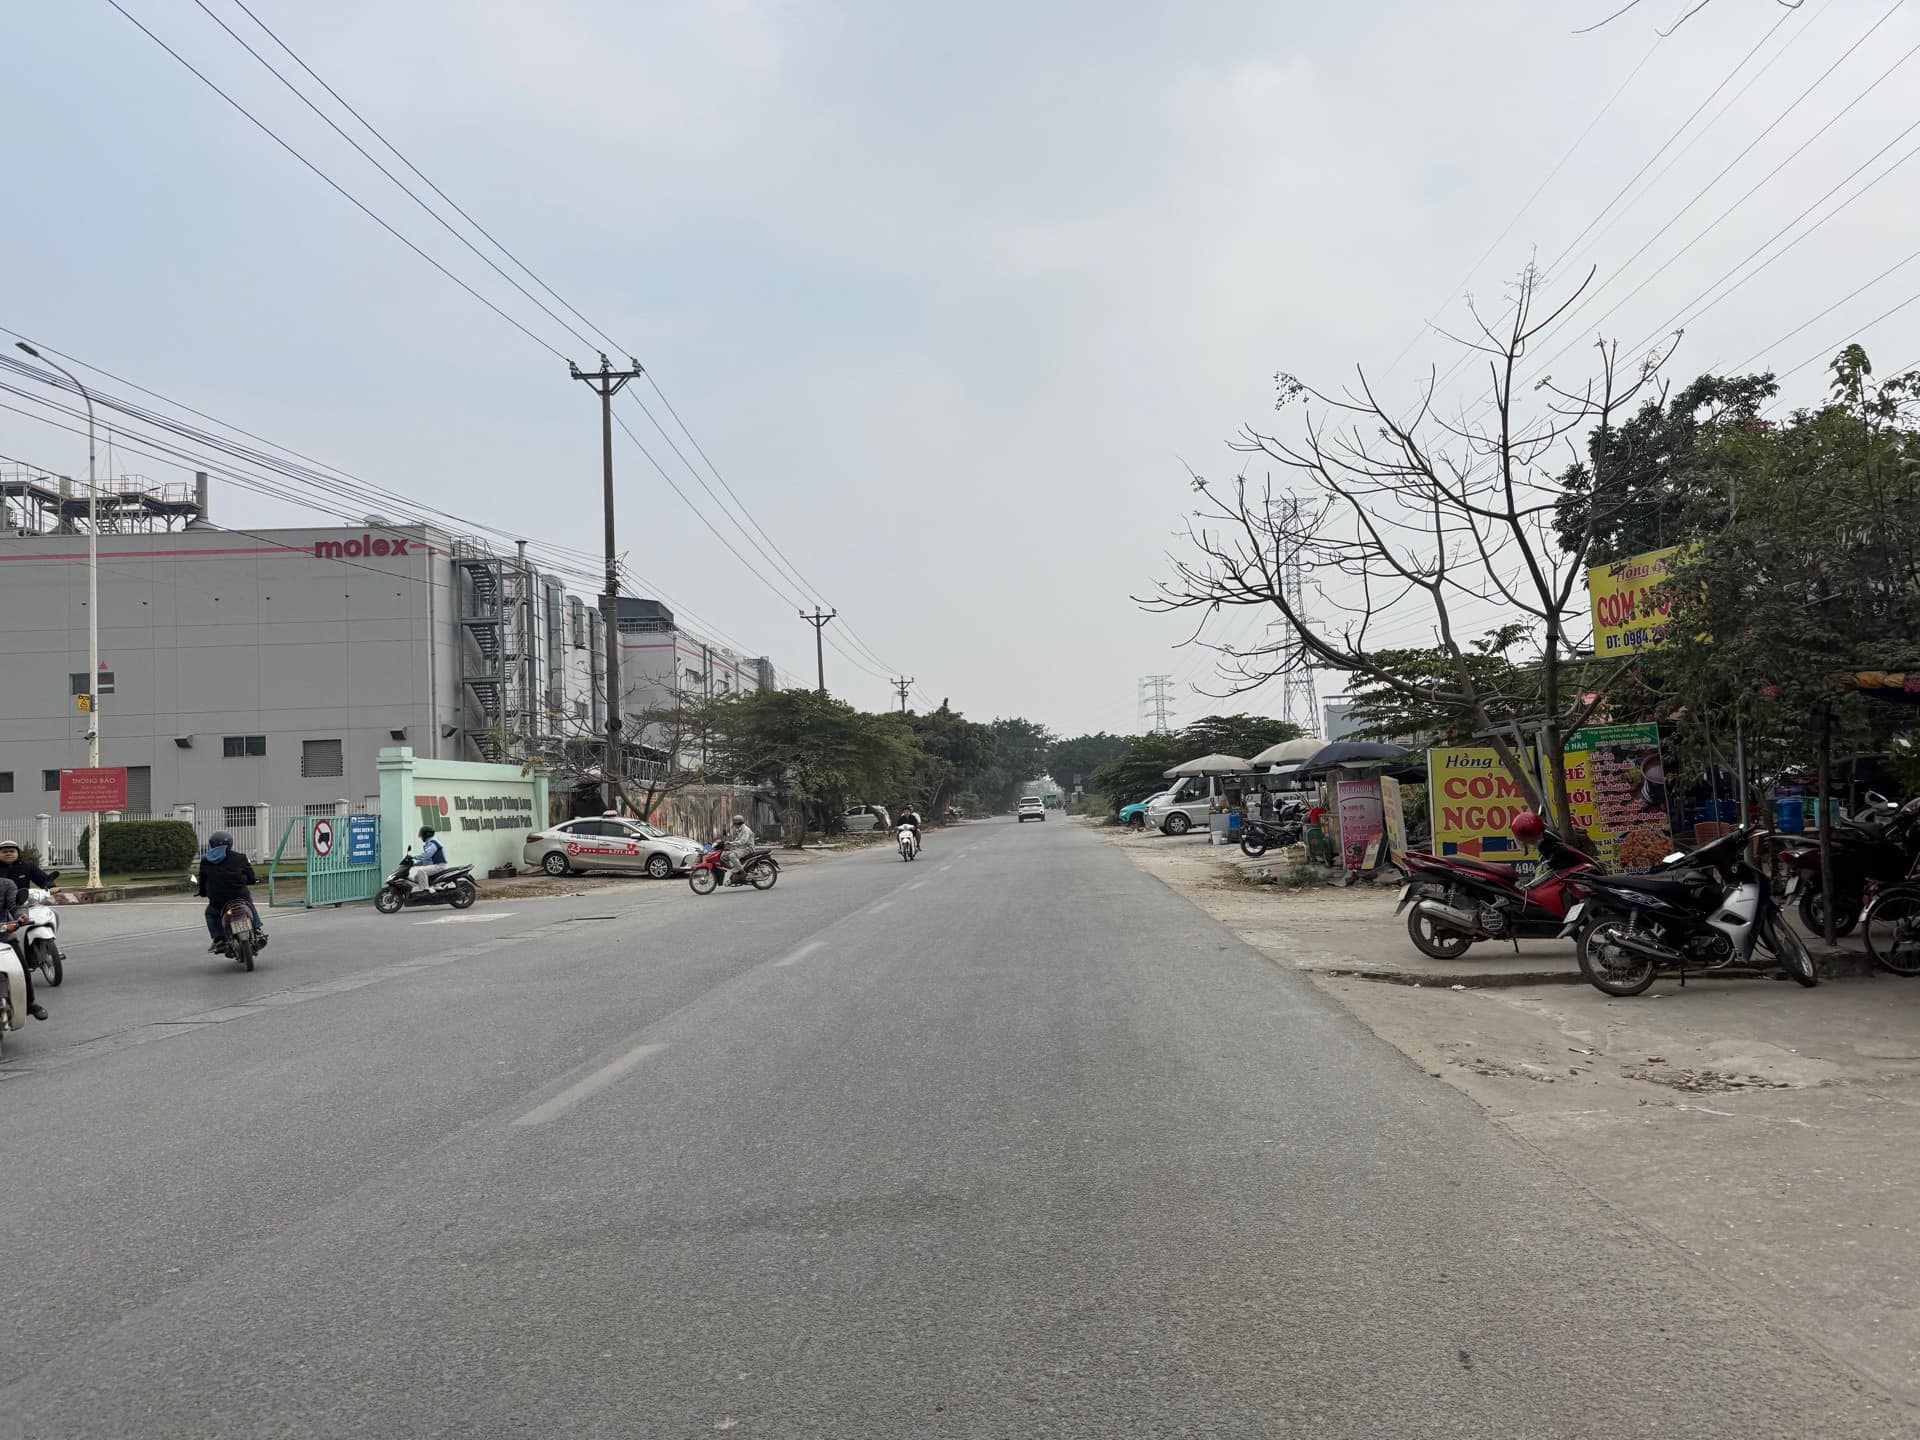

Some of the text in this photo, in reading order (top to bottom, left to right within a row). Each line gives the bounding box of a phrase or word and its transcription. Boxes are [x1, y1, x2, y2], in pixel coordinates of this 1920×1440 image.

[315, 534, 409, 559] molex
[1445, 753, 1492, 769] Hồng
[1443, 772, 1521, 800] CƠM
